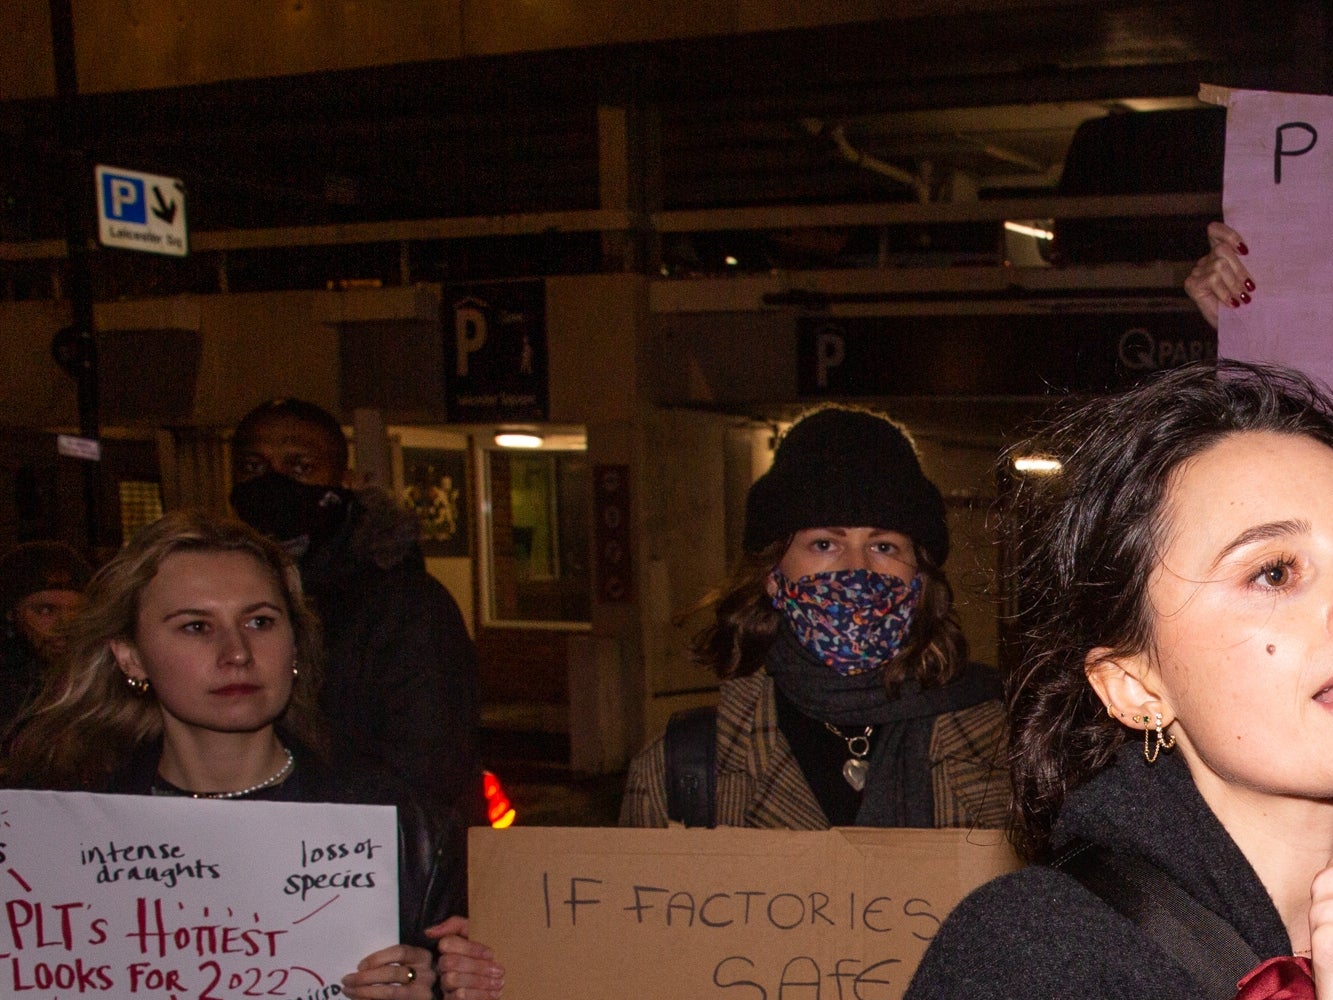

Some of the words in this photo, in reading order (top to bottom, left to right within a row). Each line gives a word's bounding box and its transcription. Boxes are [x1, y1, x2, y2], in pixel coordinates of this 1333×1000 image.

[111, 179, 137, 217] P
[455, 307, 487, 377] P
[80, 841, 185, 866] intense
[302, 840, 350, 868] loss
[353, 838, 383, 860] of
[97, 858, 221, 888] draughts
[284, 869, 376, 902] species
[543, 871, 603, 929] IF
[623, 885, 942, 941] FACTORIES
[5, 898, 108, 951] PLT's
[127, 962, 188, 993] FOR
